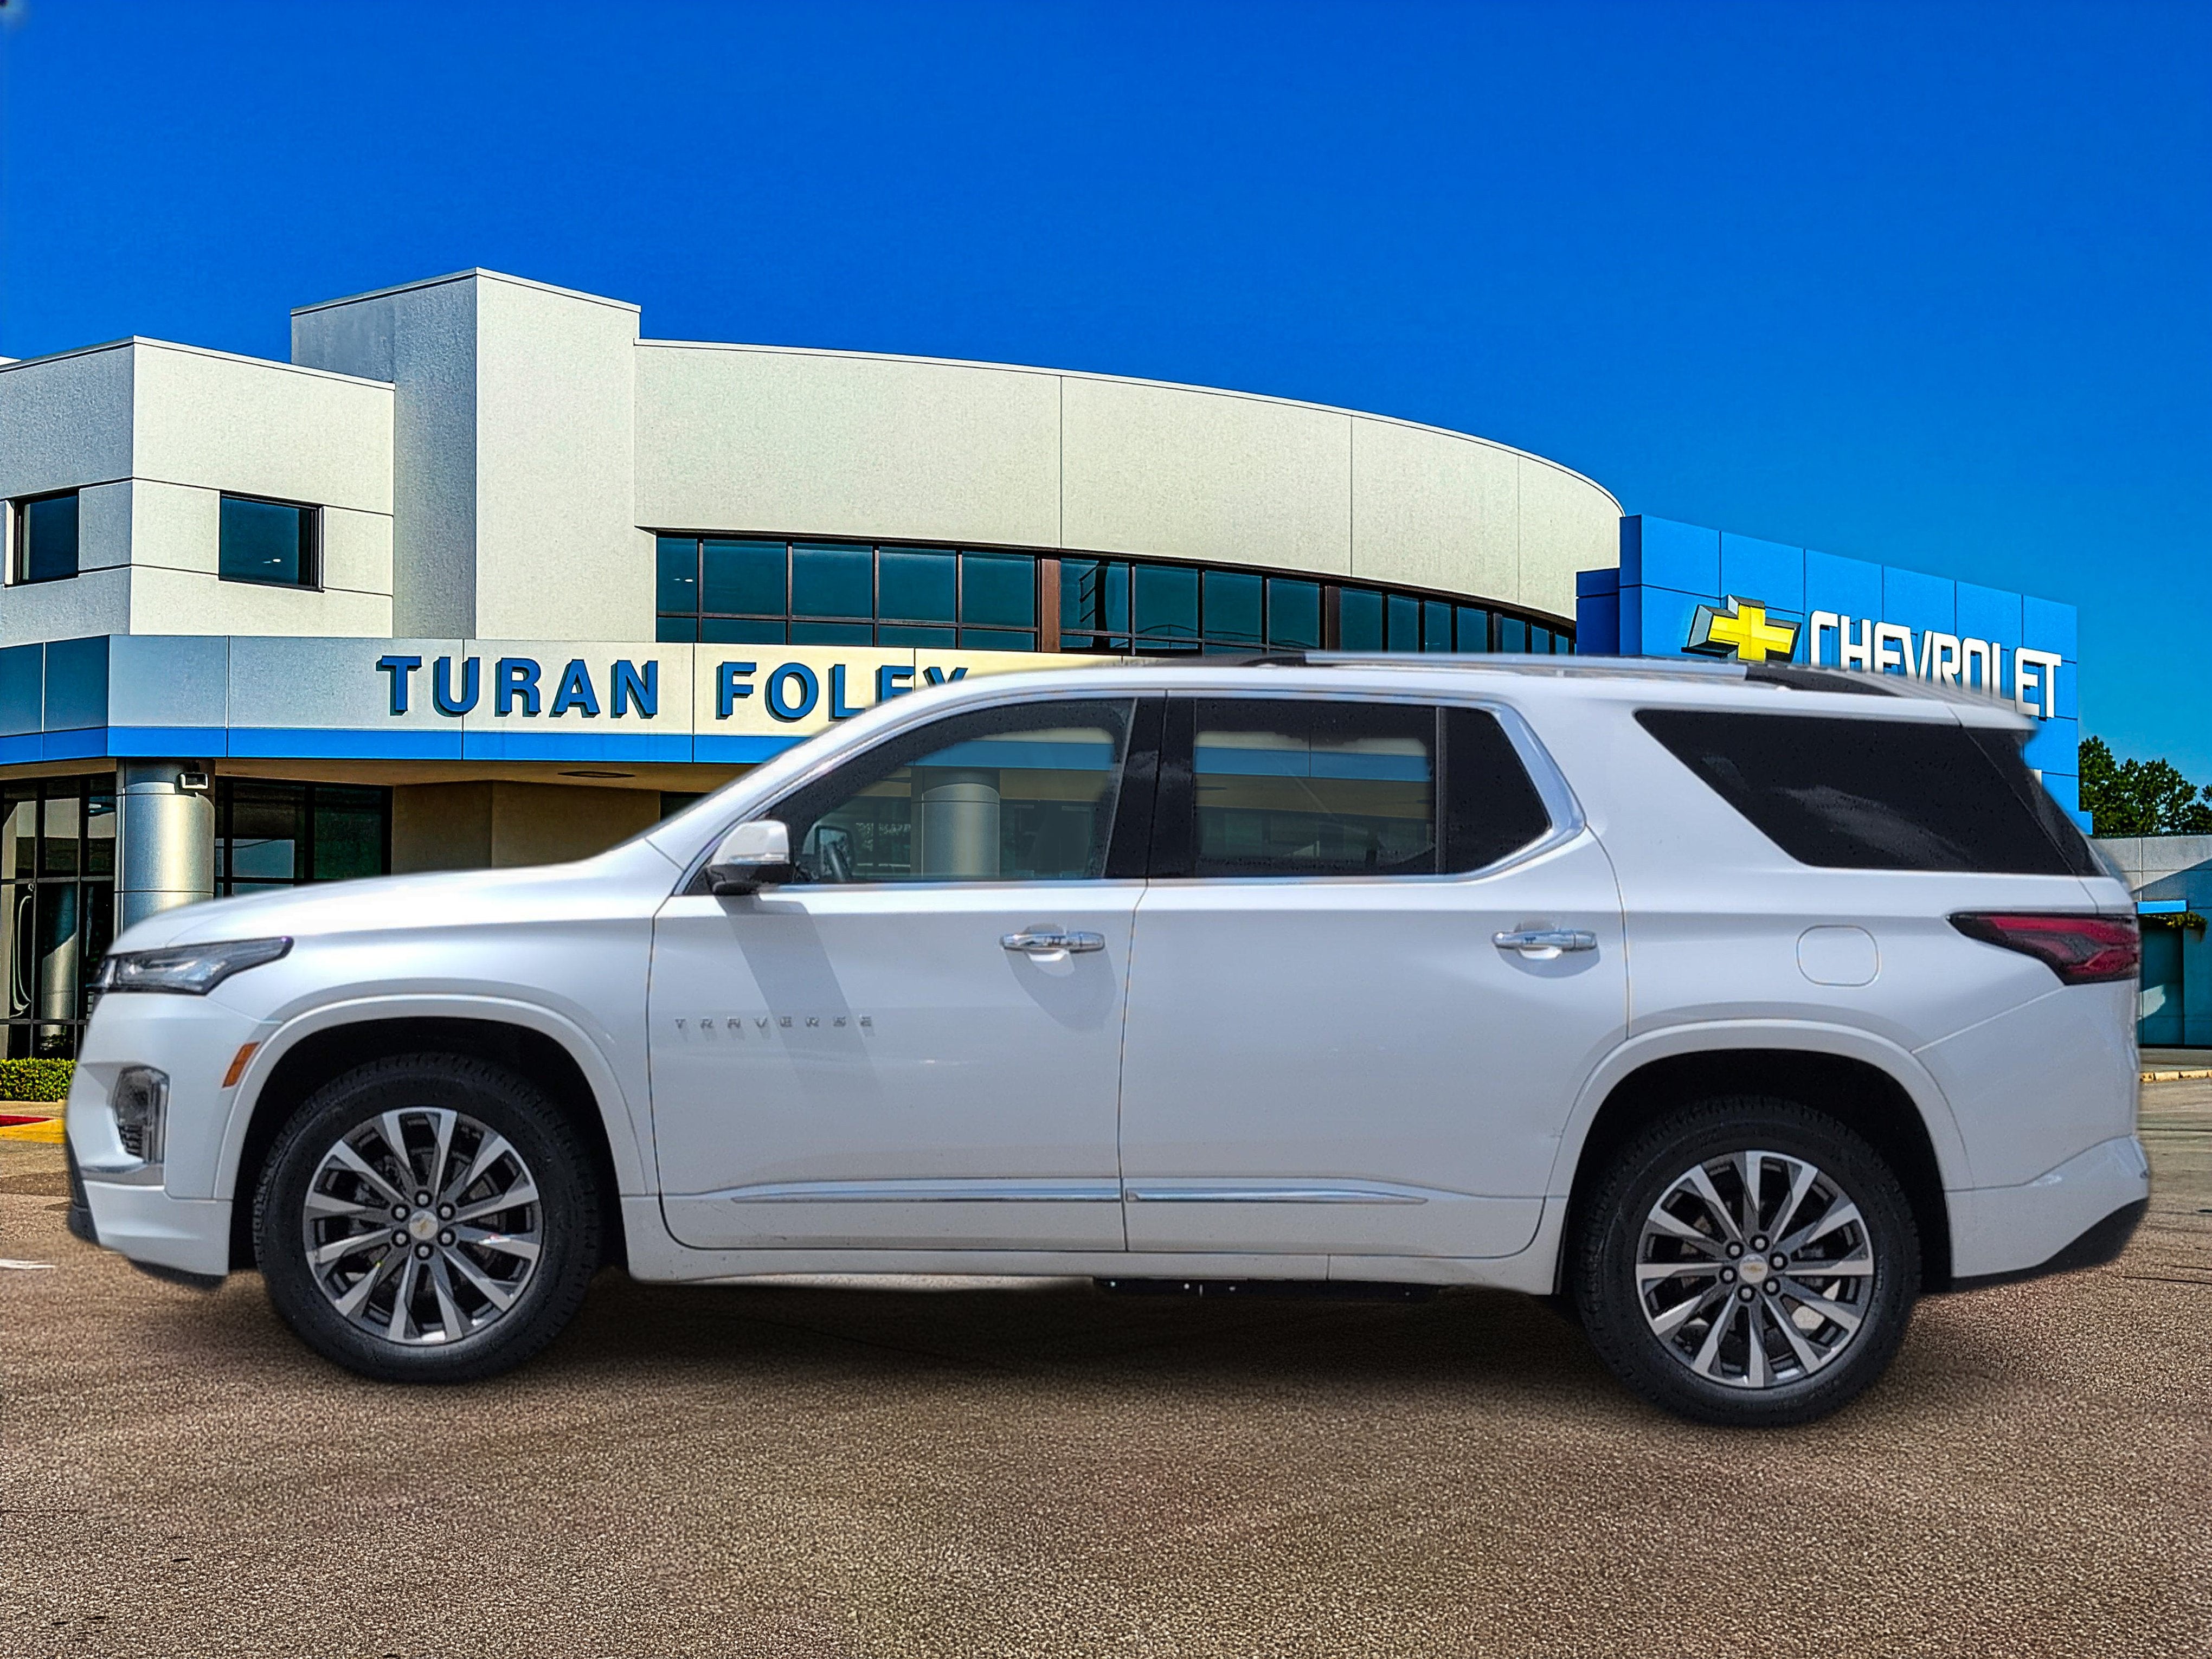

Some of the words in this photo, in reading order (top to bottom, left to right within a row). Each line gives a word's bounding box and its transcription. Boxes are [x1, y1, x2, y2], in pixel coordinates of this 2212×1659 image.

[375, 655, 658, 718] TURAN
[1810, 610, 2062, 718] CHEVROLET
[674, 1015, 872, 1029] TRAVERSE
